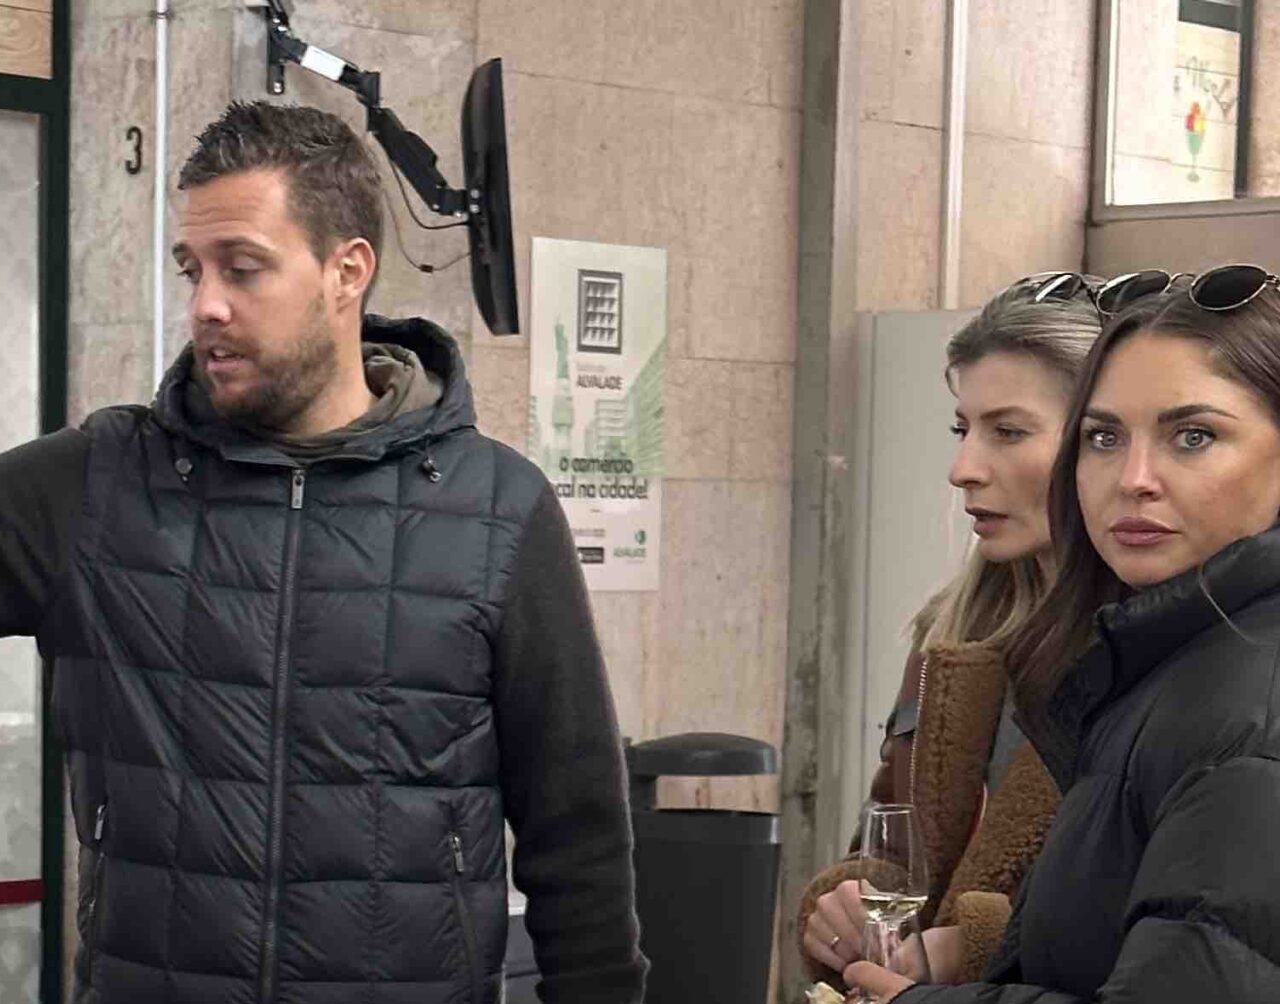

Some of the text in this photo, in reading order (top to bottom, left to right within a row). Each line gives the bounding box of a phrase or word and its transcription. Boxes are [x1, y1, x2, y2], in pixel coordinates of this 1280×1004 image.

[125, 126, 143, 175] 3
[556, 475, 575, 499] cal
[578, 484, 596, 499] na
